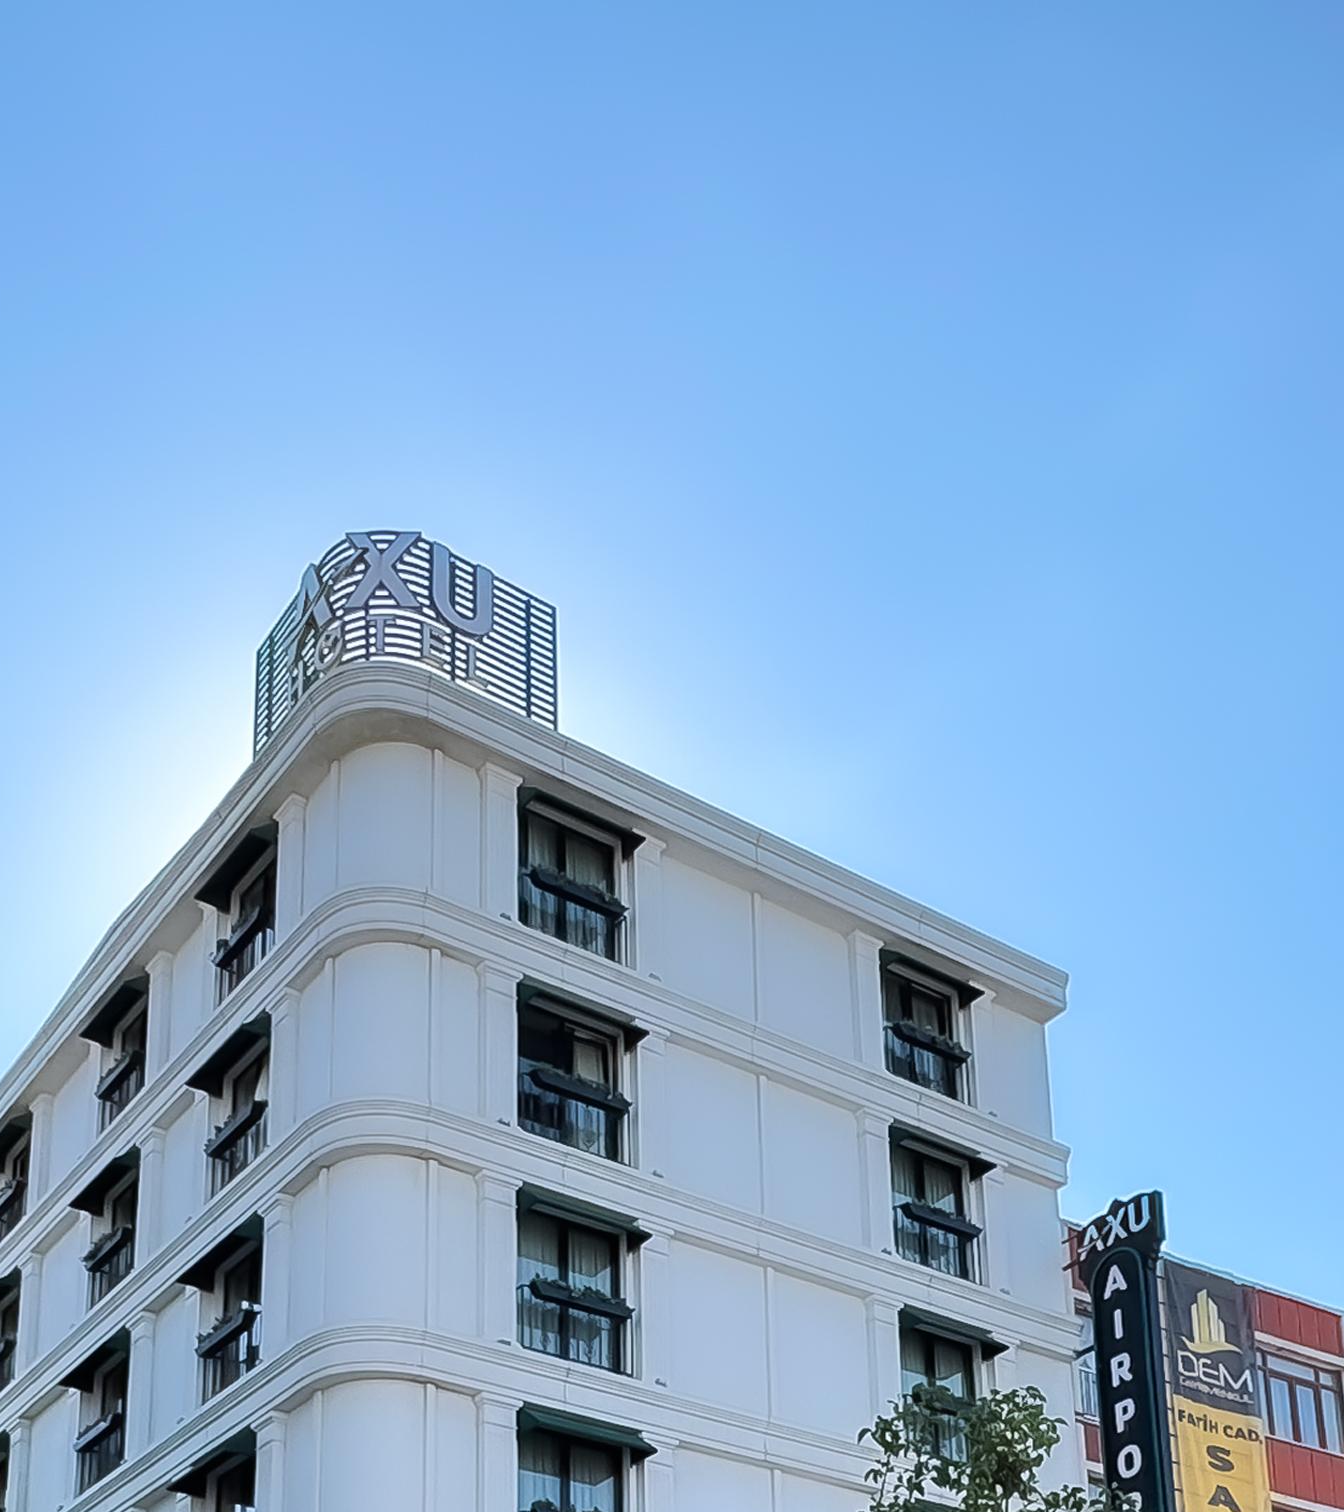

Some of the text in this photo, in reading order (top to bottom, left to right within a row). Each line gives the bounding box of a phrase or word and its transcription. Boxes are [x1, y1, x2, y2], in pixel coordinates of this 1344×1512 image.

[286, 531, 494, 672] AXU
[287, 614, 488, 708] HOTEL
[1078, 1195, 1150, 1261] AXU
[1177, 1350, 1253, 1393] DEM
[1178, 1409, 1263, 1445] FATİH CAD.
